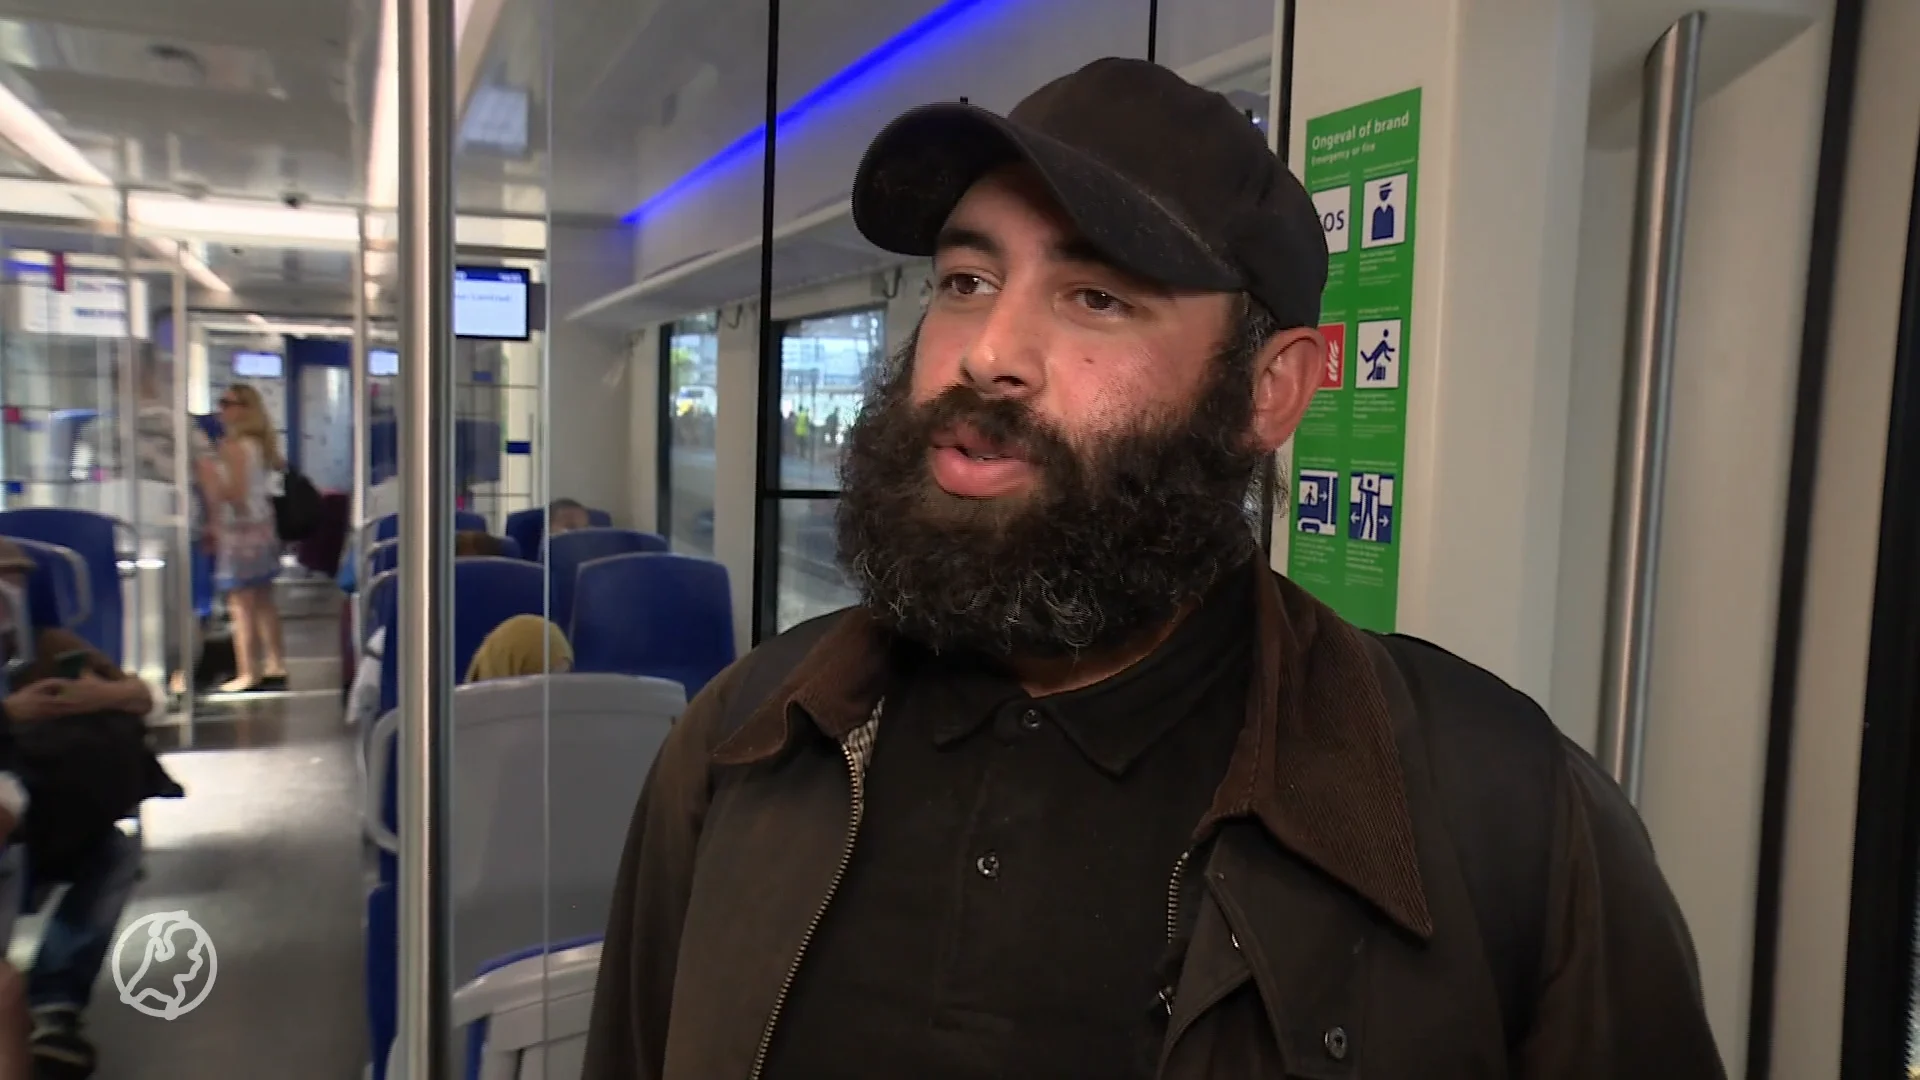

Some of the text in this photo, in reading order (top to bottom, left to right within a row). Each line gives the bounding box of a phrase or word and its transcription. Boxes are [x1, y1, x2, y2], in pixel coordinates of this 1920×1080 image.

[1312, 112, 1410, 150] Ongeval of brand
[1311, 143, 1376, 166] Emergency or fire
